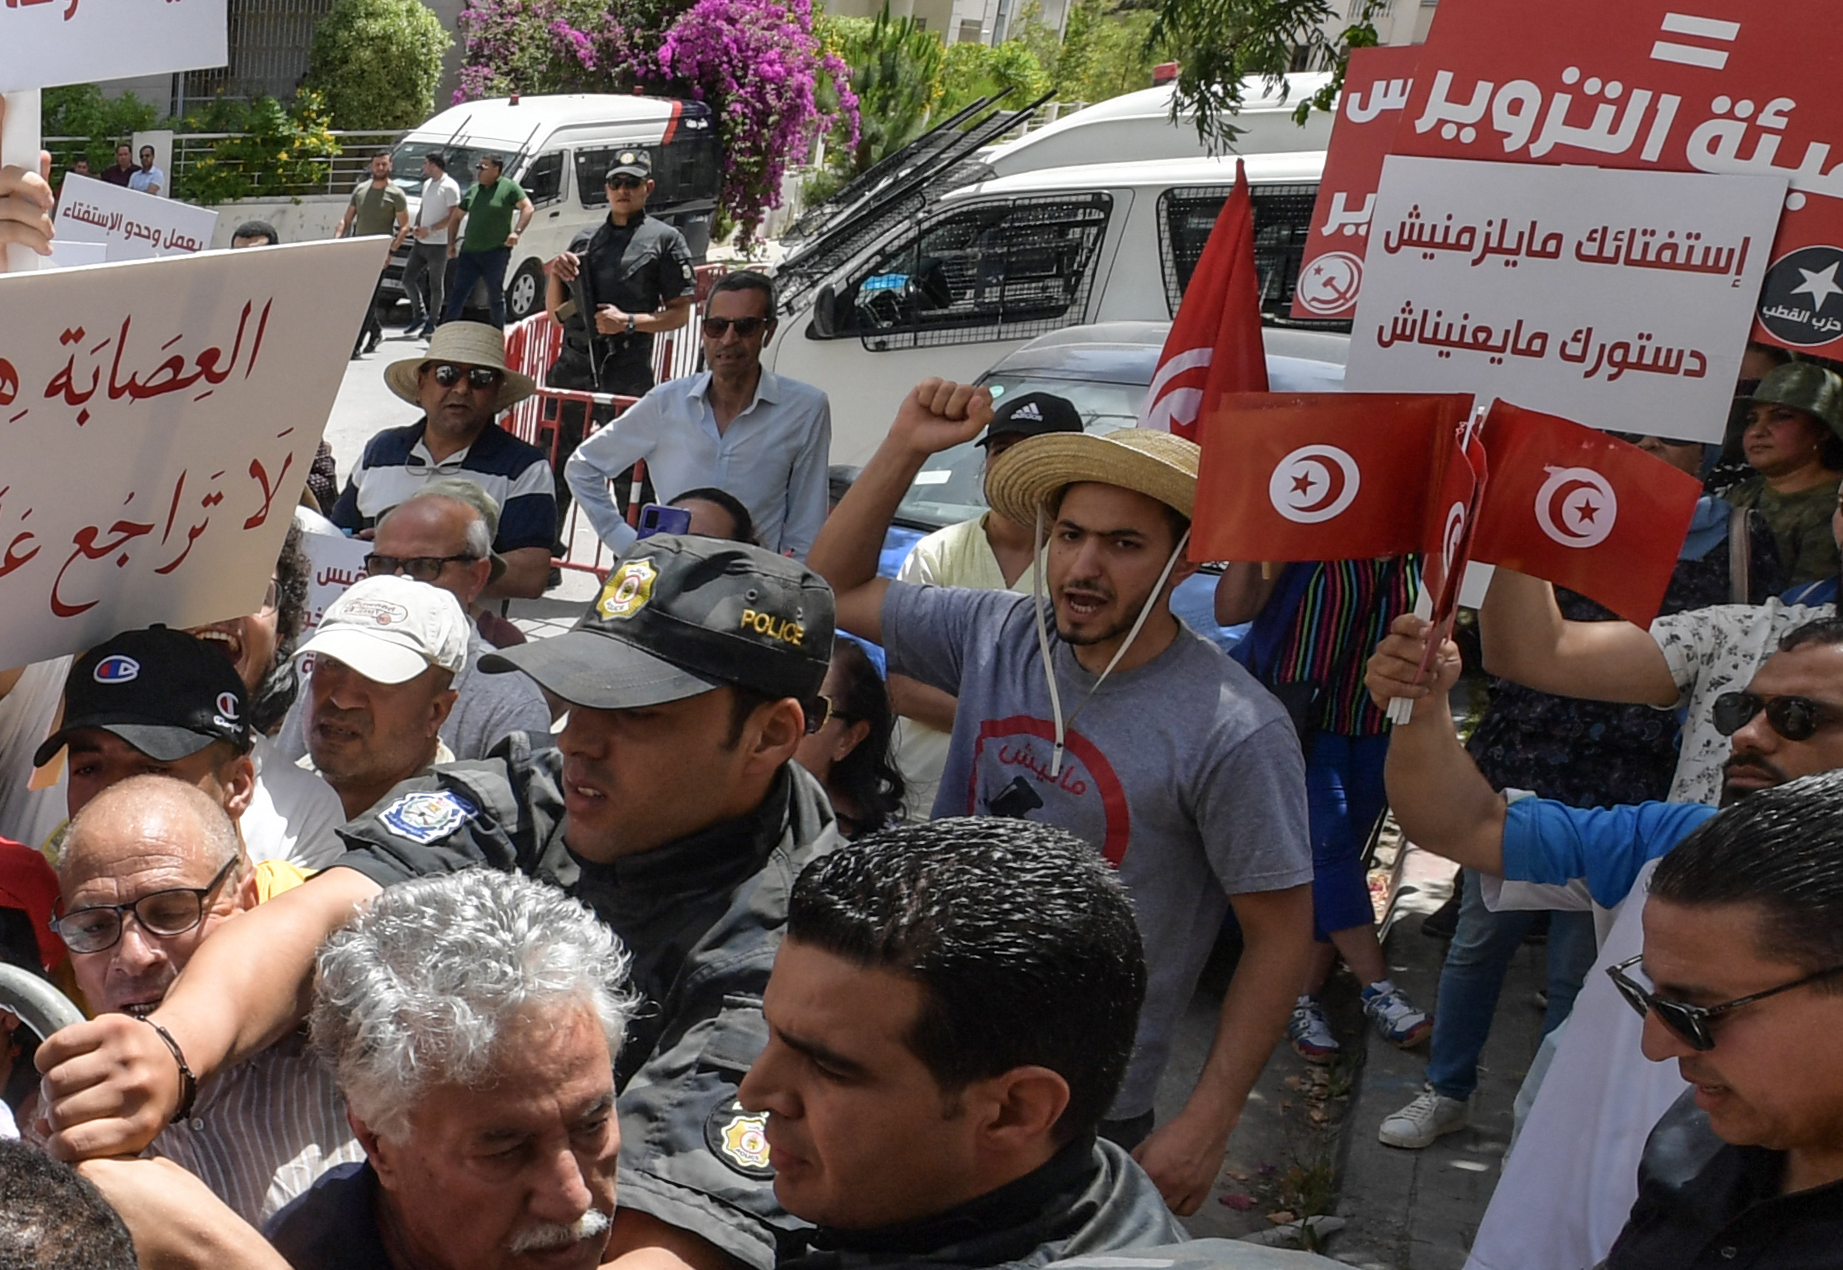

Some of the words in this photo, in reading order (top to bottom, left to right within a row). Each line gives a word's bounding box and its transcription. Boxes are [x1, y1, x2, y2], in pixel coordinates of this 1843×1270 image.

[1415, 66, 1681, 163] التزوير
[1685, 96, 1843, 212] يئة
[62, 200, 124, 236] الإستفتاء
[124, 220, 162, 249] وحدو
[1383, 203, 1564, 268] مايلزمنيش
[1574, 225, 1752, 288] إستفتائك
[1376, 300, 1550, 366] مايعنيناش
[1762, 304, 1811, 323] القطب
[1811, 316, 1842, 332] حزب
[1559, 326, 1708, 382] دستورك
[741, 608, 805, 647] POLICE
